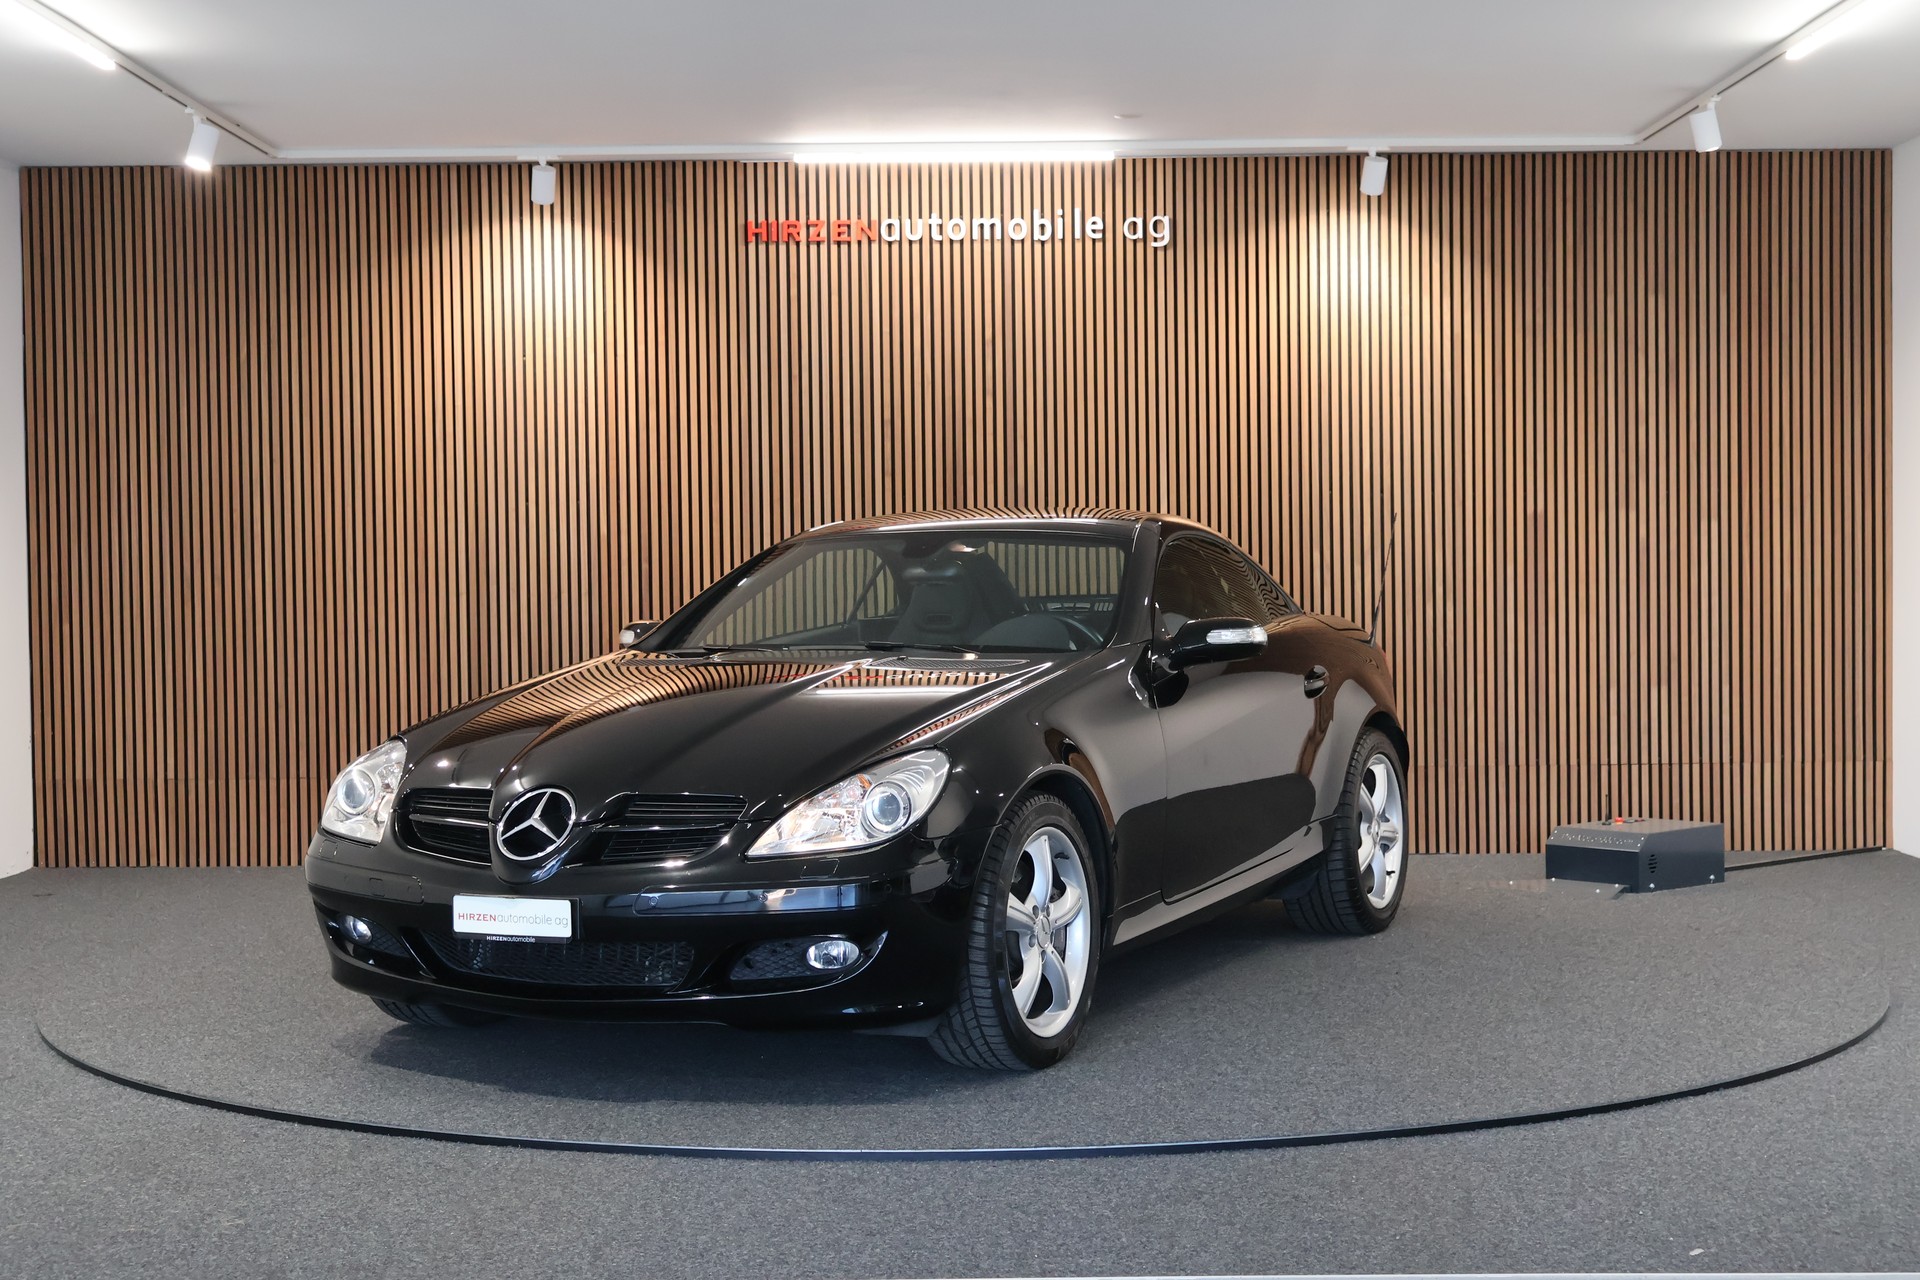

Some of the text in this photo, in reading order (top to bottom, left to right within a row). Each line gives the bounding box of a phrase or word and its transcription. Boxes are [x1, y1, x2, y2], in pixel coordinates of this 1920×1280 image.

[746, 208, 1170, 248] HIRZENautomobile ag
[458, 912, 569, 929] HIRZENautomobile ag
